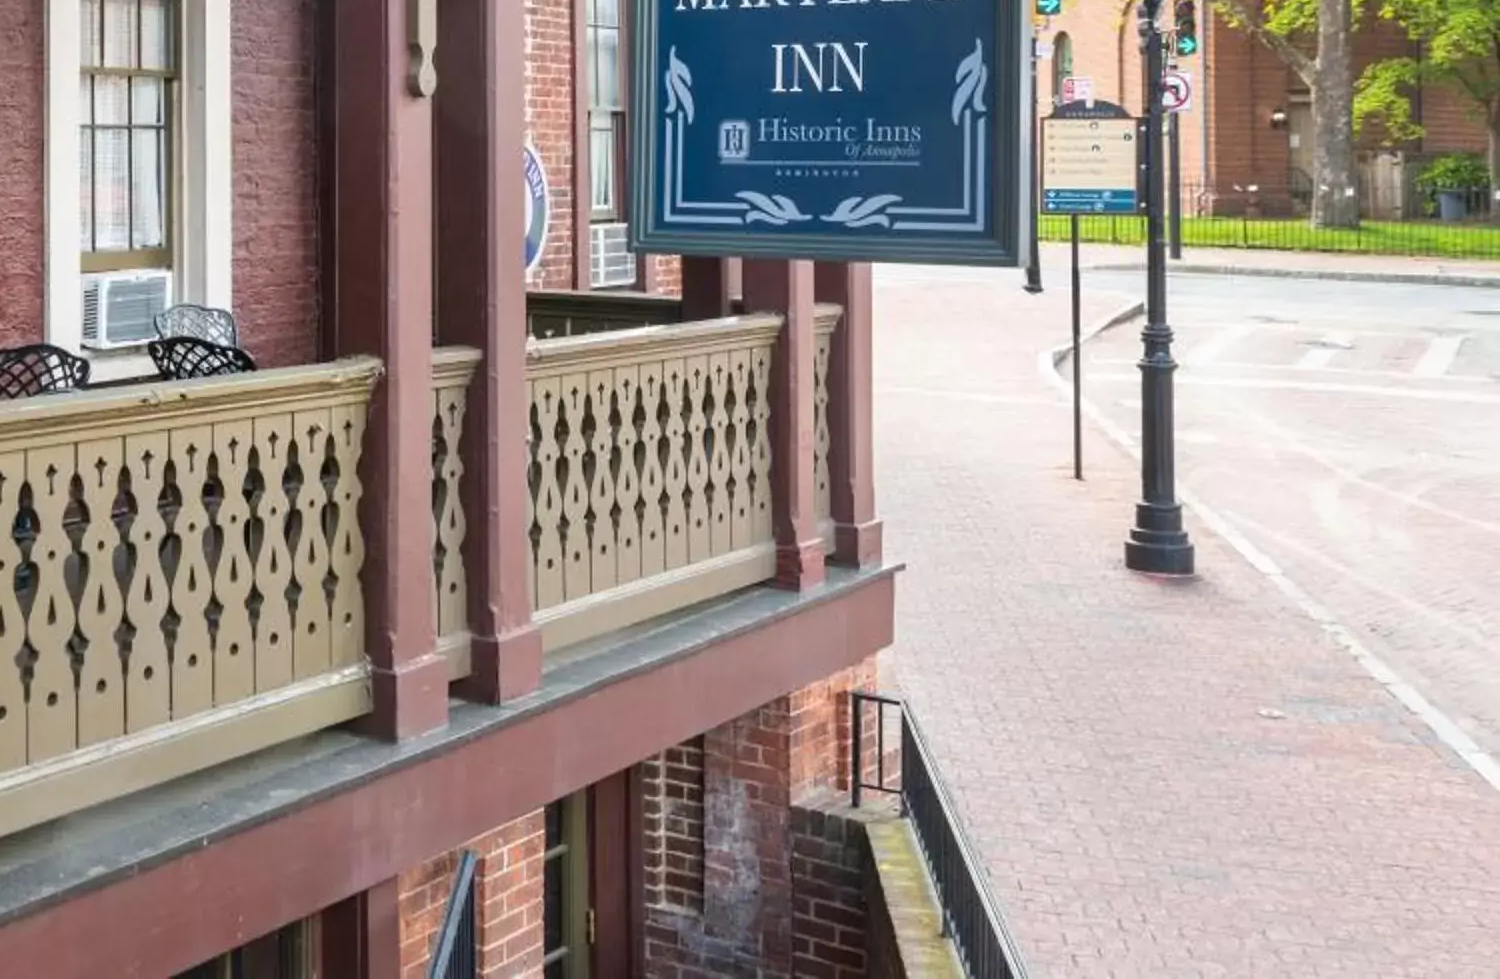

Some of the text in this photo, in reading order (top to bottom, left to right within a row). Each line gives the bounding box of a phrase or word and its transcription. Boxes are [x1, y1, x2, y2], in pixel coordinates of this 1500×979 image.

[770, 42, 868, 93] INN
[757, 116, 857, 142] Historic
[866, 117, 921, 142] Inns
[845, 143, 860, 159] Of
